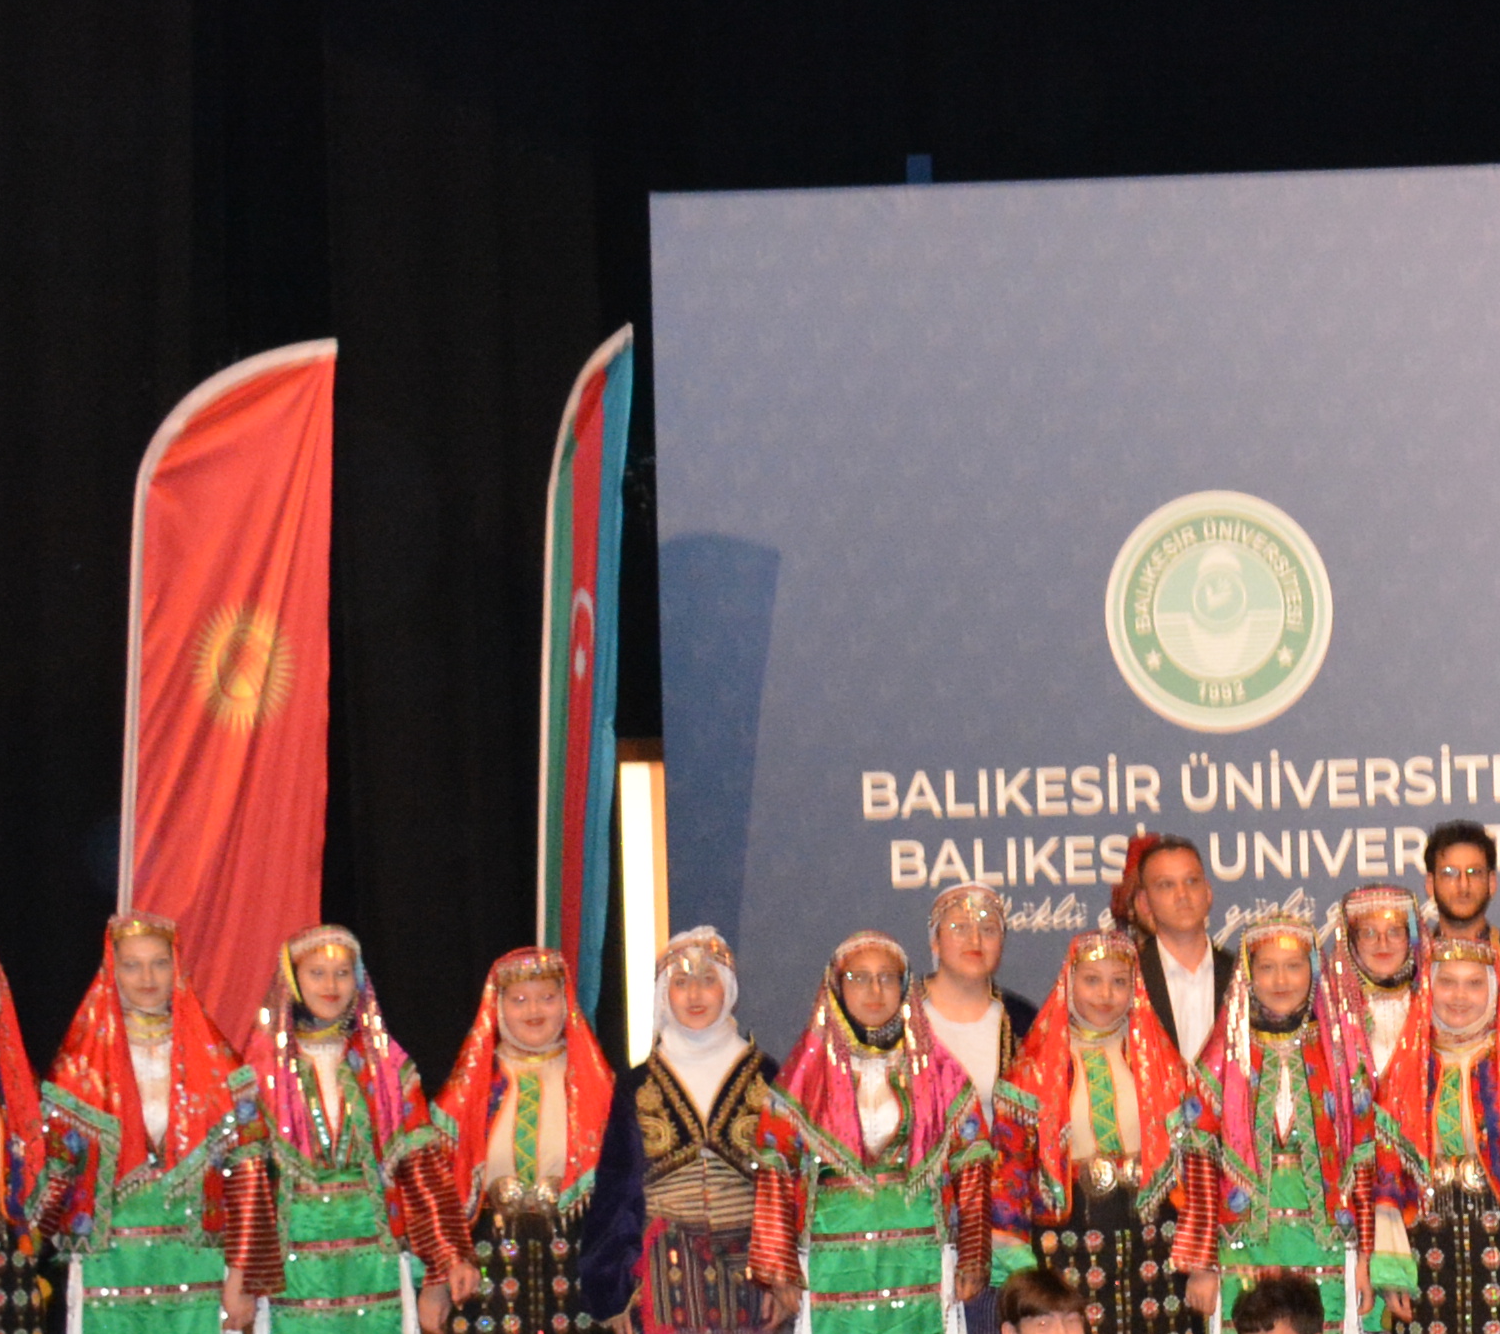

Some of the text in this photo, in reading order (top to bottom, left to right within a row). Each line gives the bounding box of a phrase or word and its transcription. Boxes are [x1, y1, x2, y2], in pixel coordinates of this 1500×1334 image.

[1134, 524, 1197, 635] BALIKESİR
[862, 753, 1161, 820] BALIKESİR
[890, 822, 1150, 889] BALIKES
